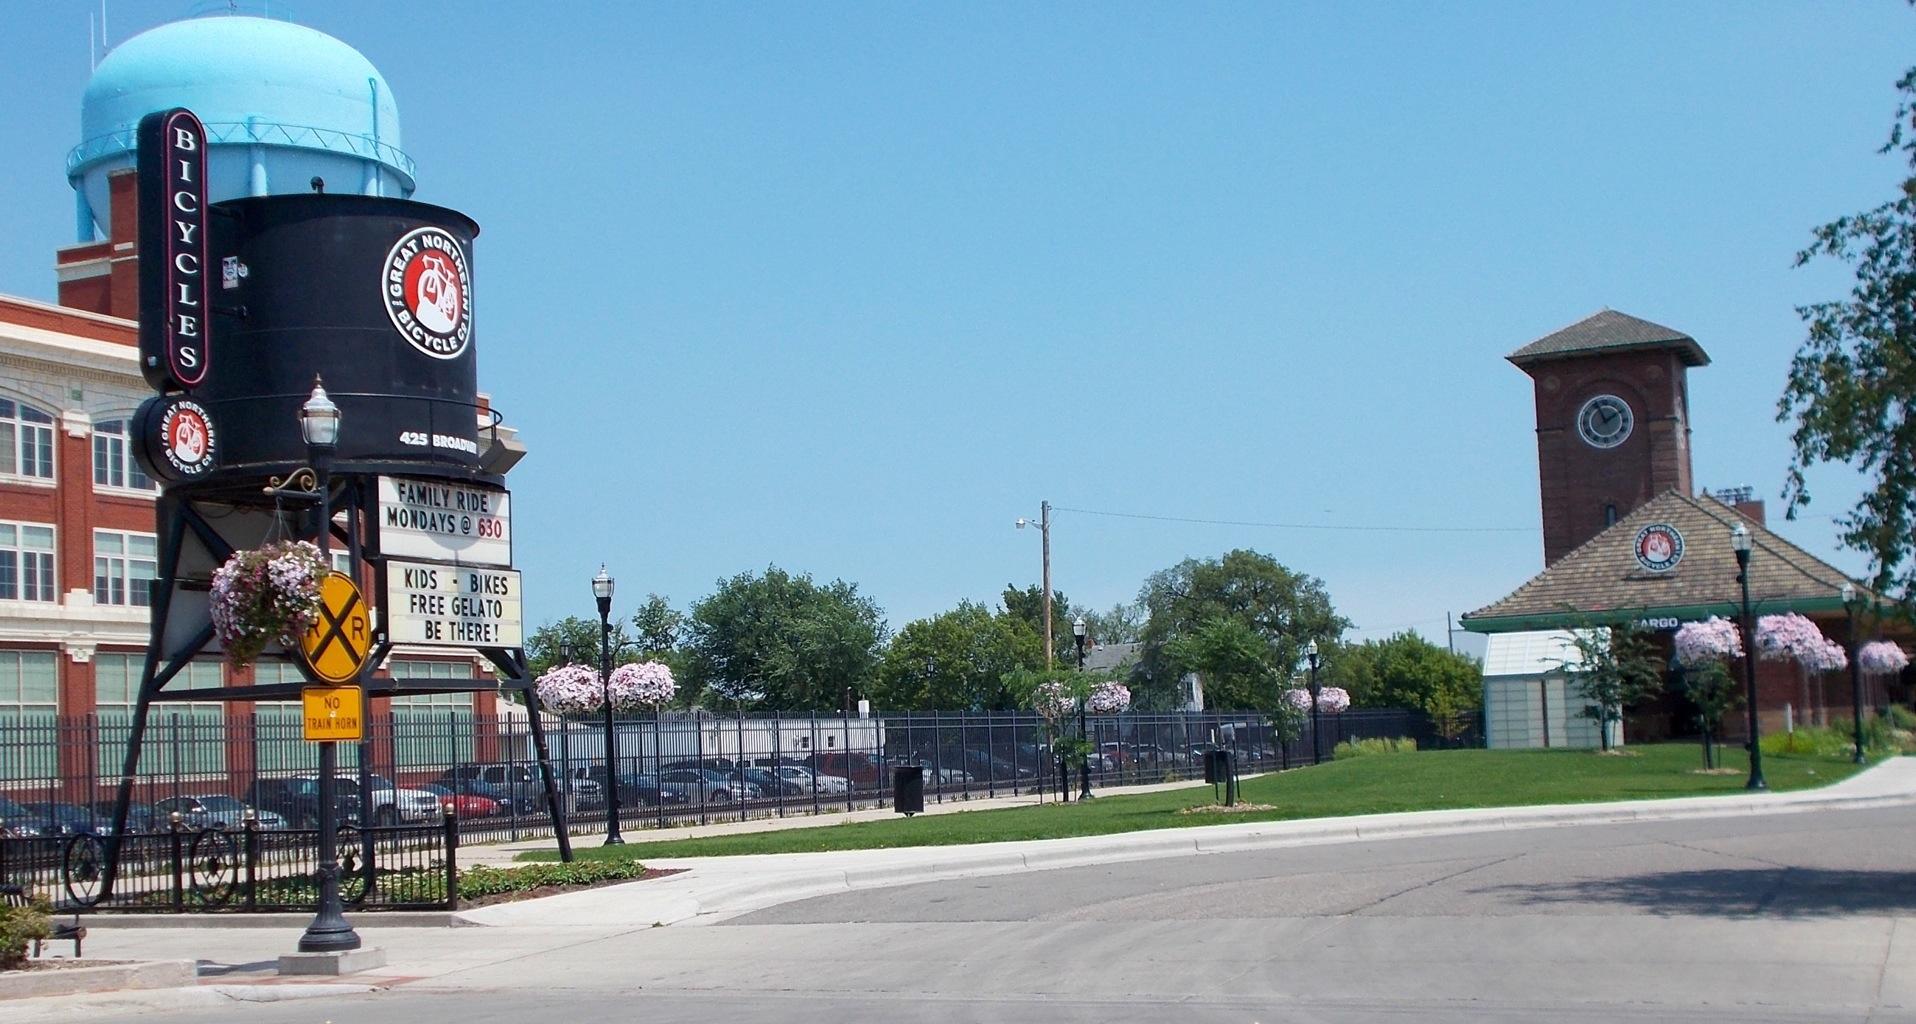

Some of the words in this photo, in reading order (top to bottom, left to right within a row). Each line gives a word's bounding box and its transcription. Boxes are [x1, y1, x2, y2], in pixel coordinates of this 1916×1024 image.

[173, 126, 199, 368] BICYCLES
[389, 239, 419, 298] GREAT
[421, 234, 470, 312] NORTHERN
[397, 309, 458, 352] BICYCLE
[161, 404, 178, 441] GREAT
[178, 400, 215, 447] NORTHERN
[399, 431, 429, 446] 425
[432, 434, 478, 455] BROADW
[165, 448, 202, 474] BICYCLE
[398, 482, 450, 508] FAMILY
[456, 490, 488, 513] RIDE
[387, 506, 456, 534] MONDAYS
[460, 515, 471, 535] @
[478, 517, 502, 539] 630
[404, 568, 438, 590] KIDS
[470, 573, 508, 596] BIKES
[410, 594, 445, 616] FREE
[451, 596, 503, 619] GELATO
[425, 620, 442, 640] BE
[323, 696, 341, 711] NO
[307, 717, 332, 731] TRAIN
[335, 716, 358, 731] HORN
